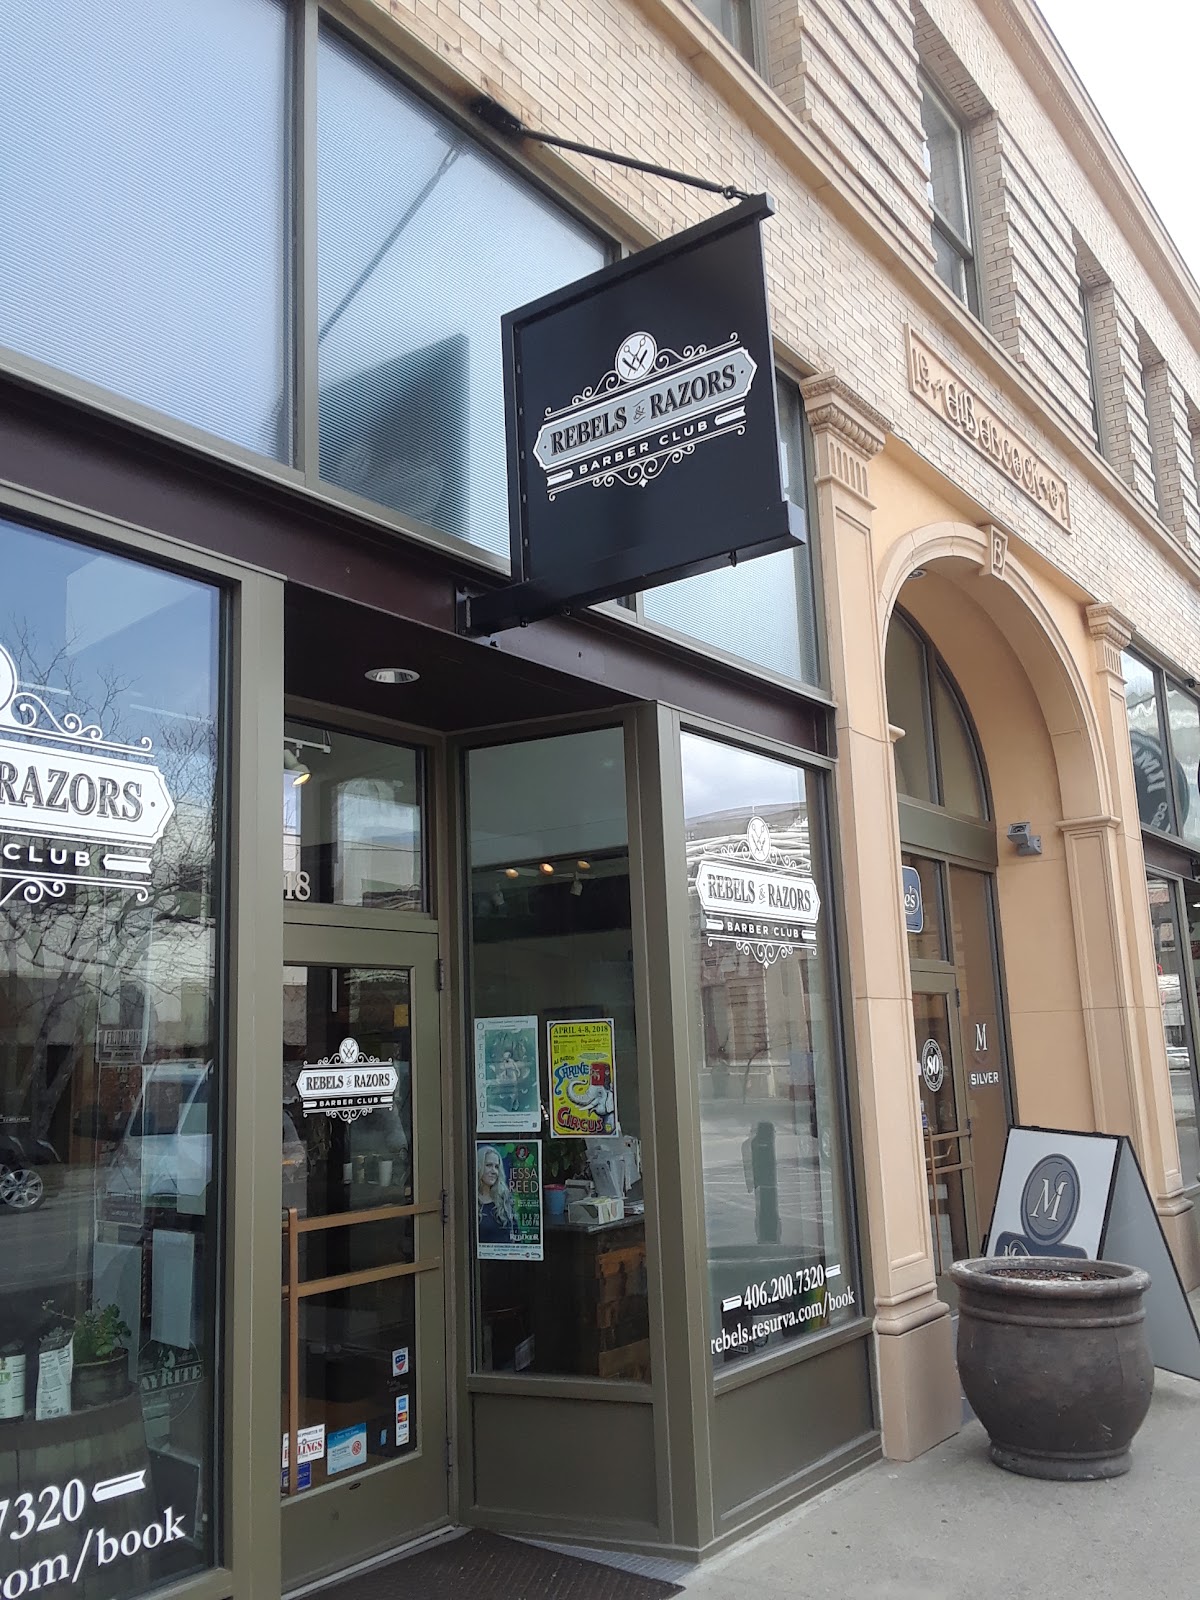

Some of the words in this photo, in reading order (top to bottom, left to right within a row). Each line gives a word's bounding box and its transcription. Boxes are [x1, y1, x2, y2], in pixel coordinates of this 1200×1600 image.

[550, 406, 627, 456] REBELS
[633, 404, 646, 422] &
[650, 363, 737, 419] RAZORS
[579, 442, 650, 475] BARBER
[659, 421, 708, 446] CLUB
[992, 537, 1003, 569] B
[0, 760, 143, 822] RAZORS
[4, 843, 91, 867] CLUB
[707, 873, 756, 904] REBELS
[768, 884, 812, 912] RAZORS
[727, 921, 769, 935] BARBER
[774, 926, 799, 938] CLUB
[553, 1026, 576, 1034] APRIL
[592, 1025, 608, 1033] 2018
[975, 1023, 987, 1051] M
[554, 1062, 589, 1095] SHRINE
[927, 1054, 939, 1076] 80
[971, 1071, 999, 1086] SILVER
[306, 1075, 344, 1091] REBELS
[354, 1073, 390, 1088] RAZORS
[319, 1098, 353, 1107] BARBER
[357, 1096, 378, 1104] CLUB
[557, 1107, 603, 1132] CIRCUS
[508, 1167, 538, 1180] JESSA
[508, 1180, 539, 1193] REED
[1029, 1178, 1068, 1221] M
[743, 1264, 825, 1311] 406.200.7320
[711, 1285, 855, 1355] rebels.resurva.com/book
[140, 1364, 202, 1390] AYRITE
[0, 1506, 188, 1600] om/book
